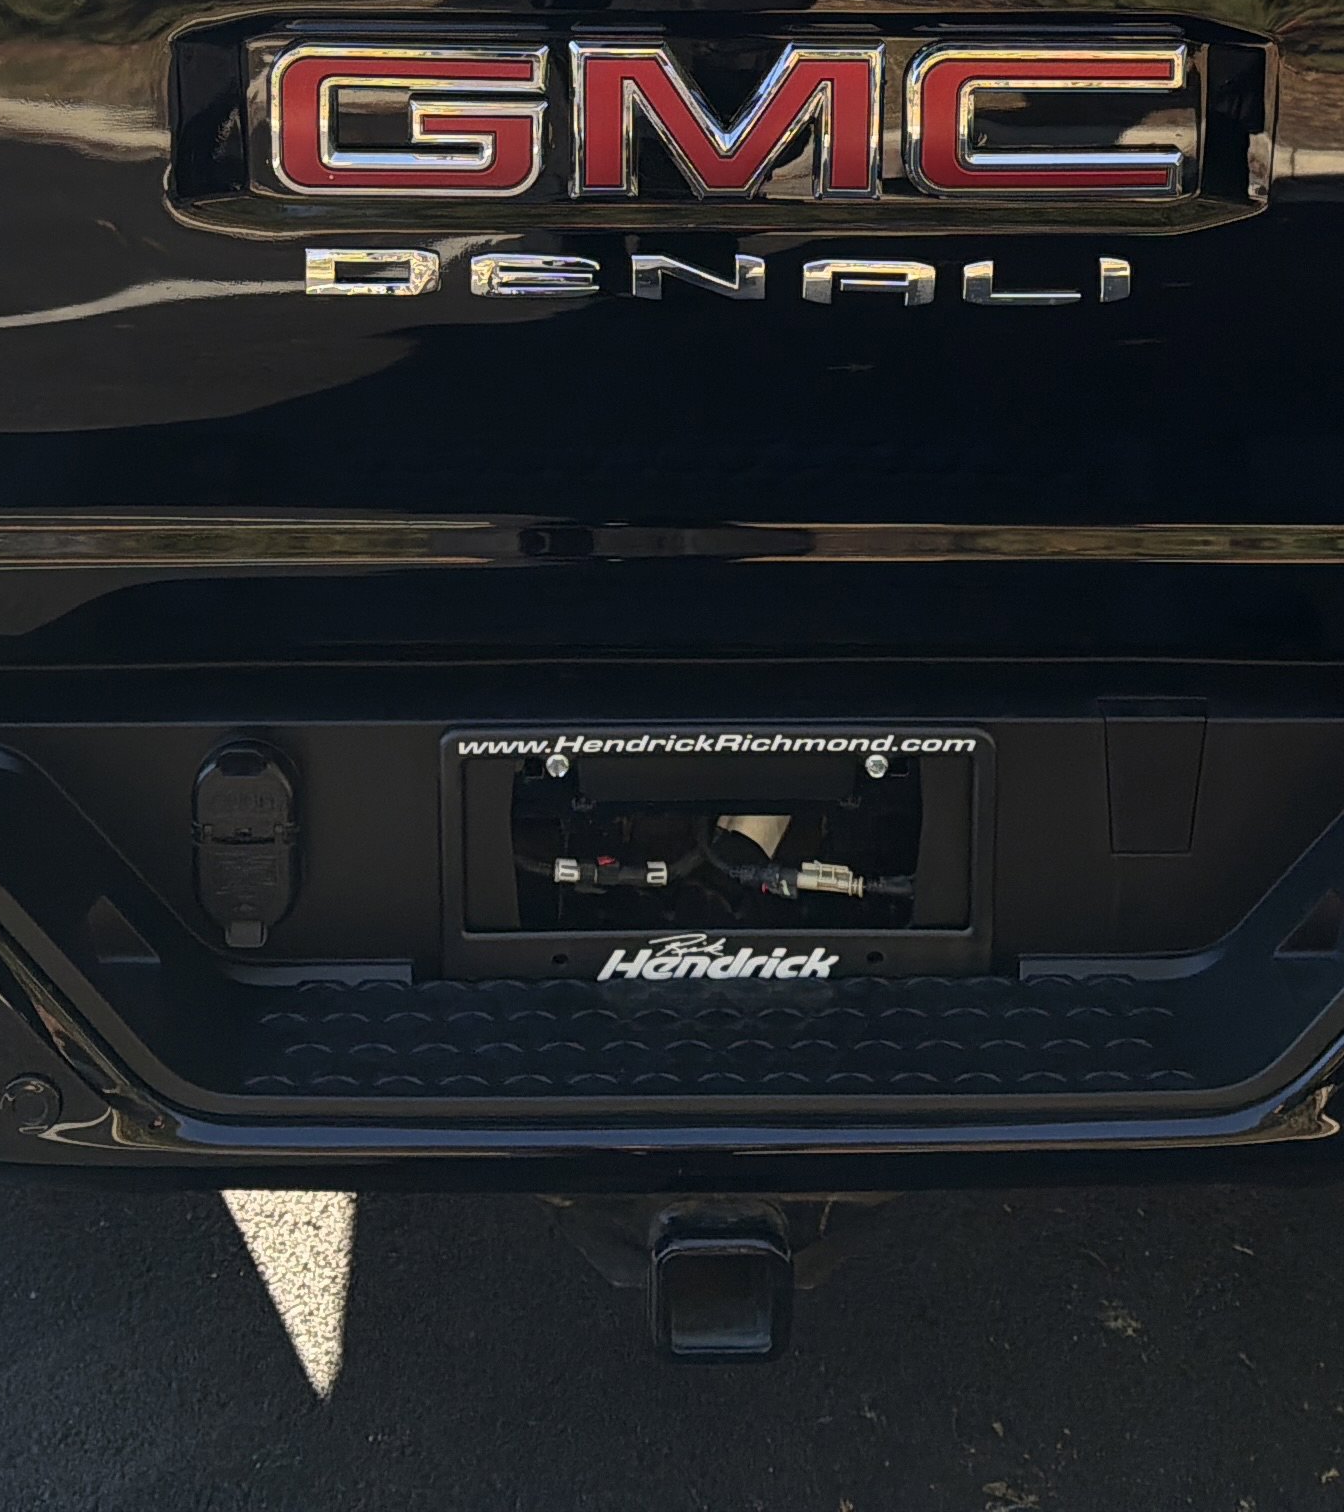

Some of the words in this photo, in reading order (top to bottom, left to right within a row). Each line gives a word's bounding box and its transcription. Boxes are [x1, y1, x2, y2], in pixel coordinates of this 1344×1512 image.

[271, 40, 1186, 197] GMC
[303, 247, 1131, 307] DENALI
[458, 734, 977, 755] www.HendrickRichmond.com
[597, 947, 839, 981] Hendrick
